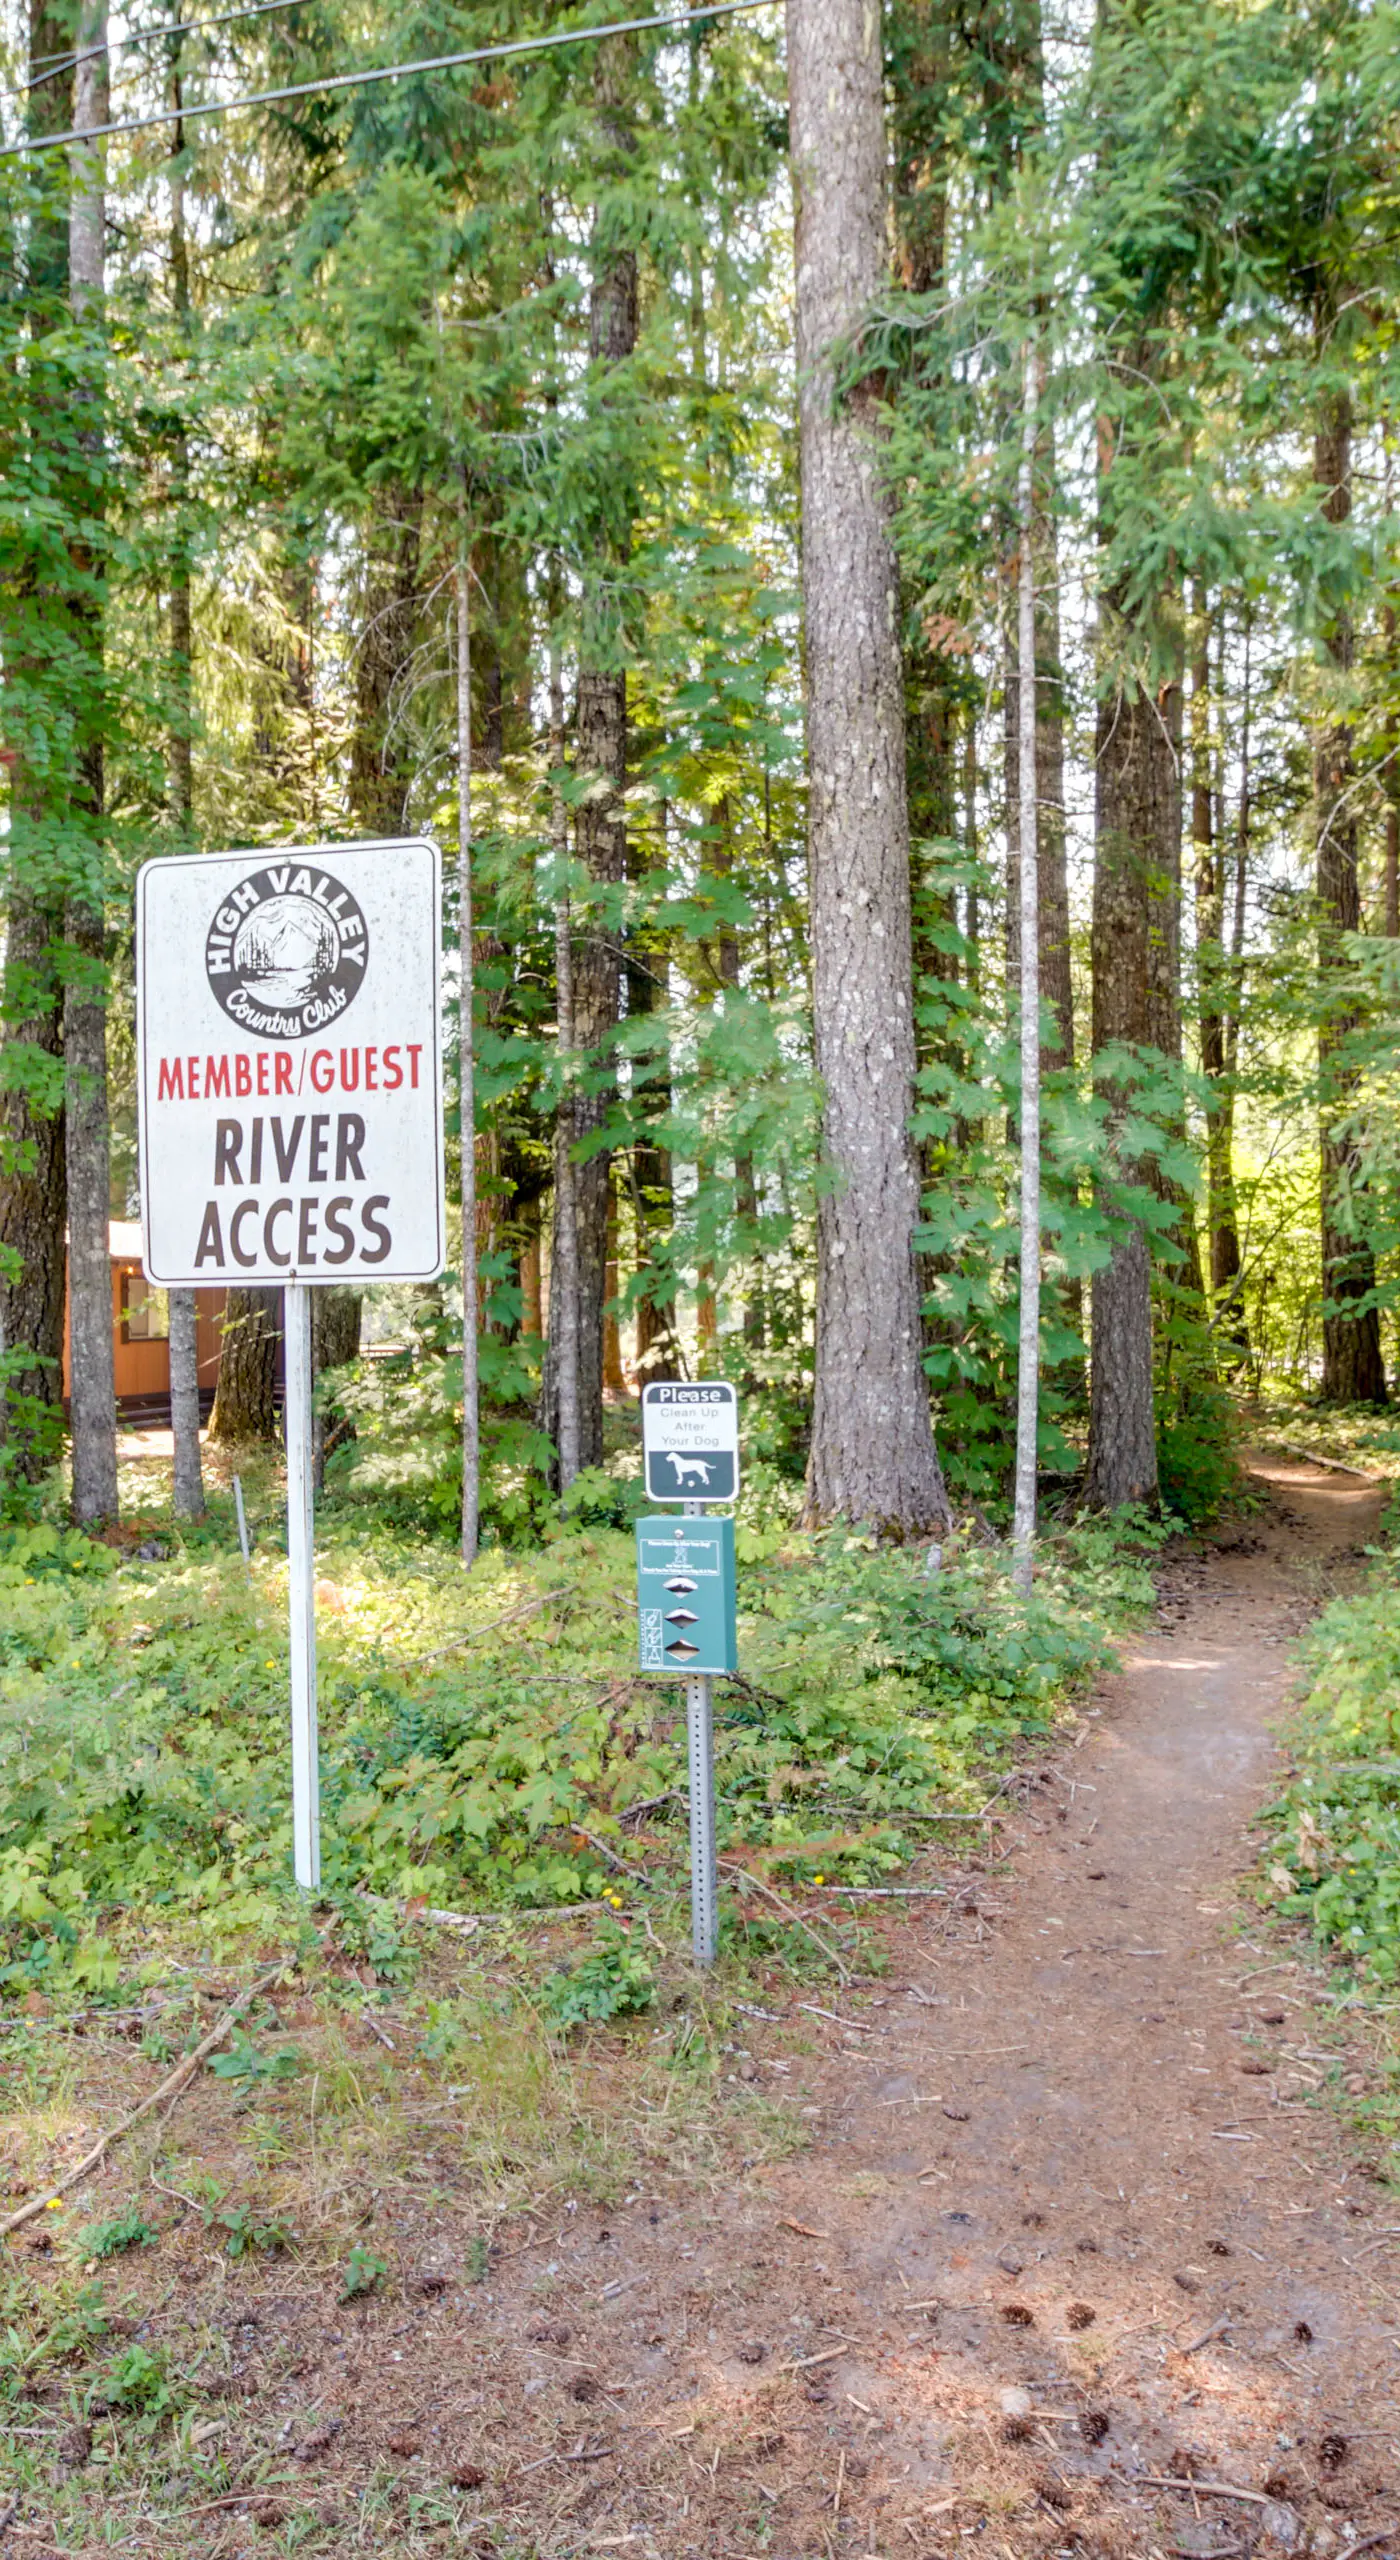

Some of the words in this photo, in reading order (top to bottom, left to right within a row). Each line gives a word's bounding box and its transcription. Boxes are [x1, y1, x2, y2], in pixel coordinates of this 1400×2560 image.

[207, 881, 260, 975] HIGH
[267, 867, 366, 967] VALLEY
[226, 988, 301, 1037] Country
[302, 984, 347, 1028] Club
[158, 1045, 423, 1100] MEMBER/GUEST
[214, 1114, 366, 1185] RIVER
[194, 1196, 392, 1268] ACCESS
[660, 1388, 721, 1402] Please
[660, 1408, 696, 1418] Clean
[702, 1408, 719, 1419] Up
[661, 1436, 689, 1446] Your
[694, 1436, 719, 1448] Dog
[675, 1422, 706, 1432] After
